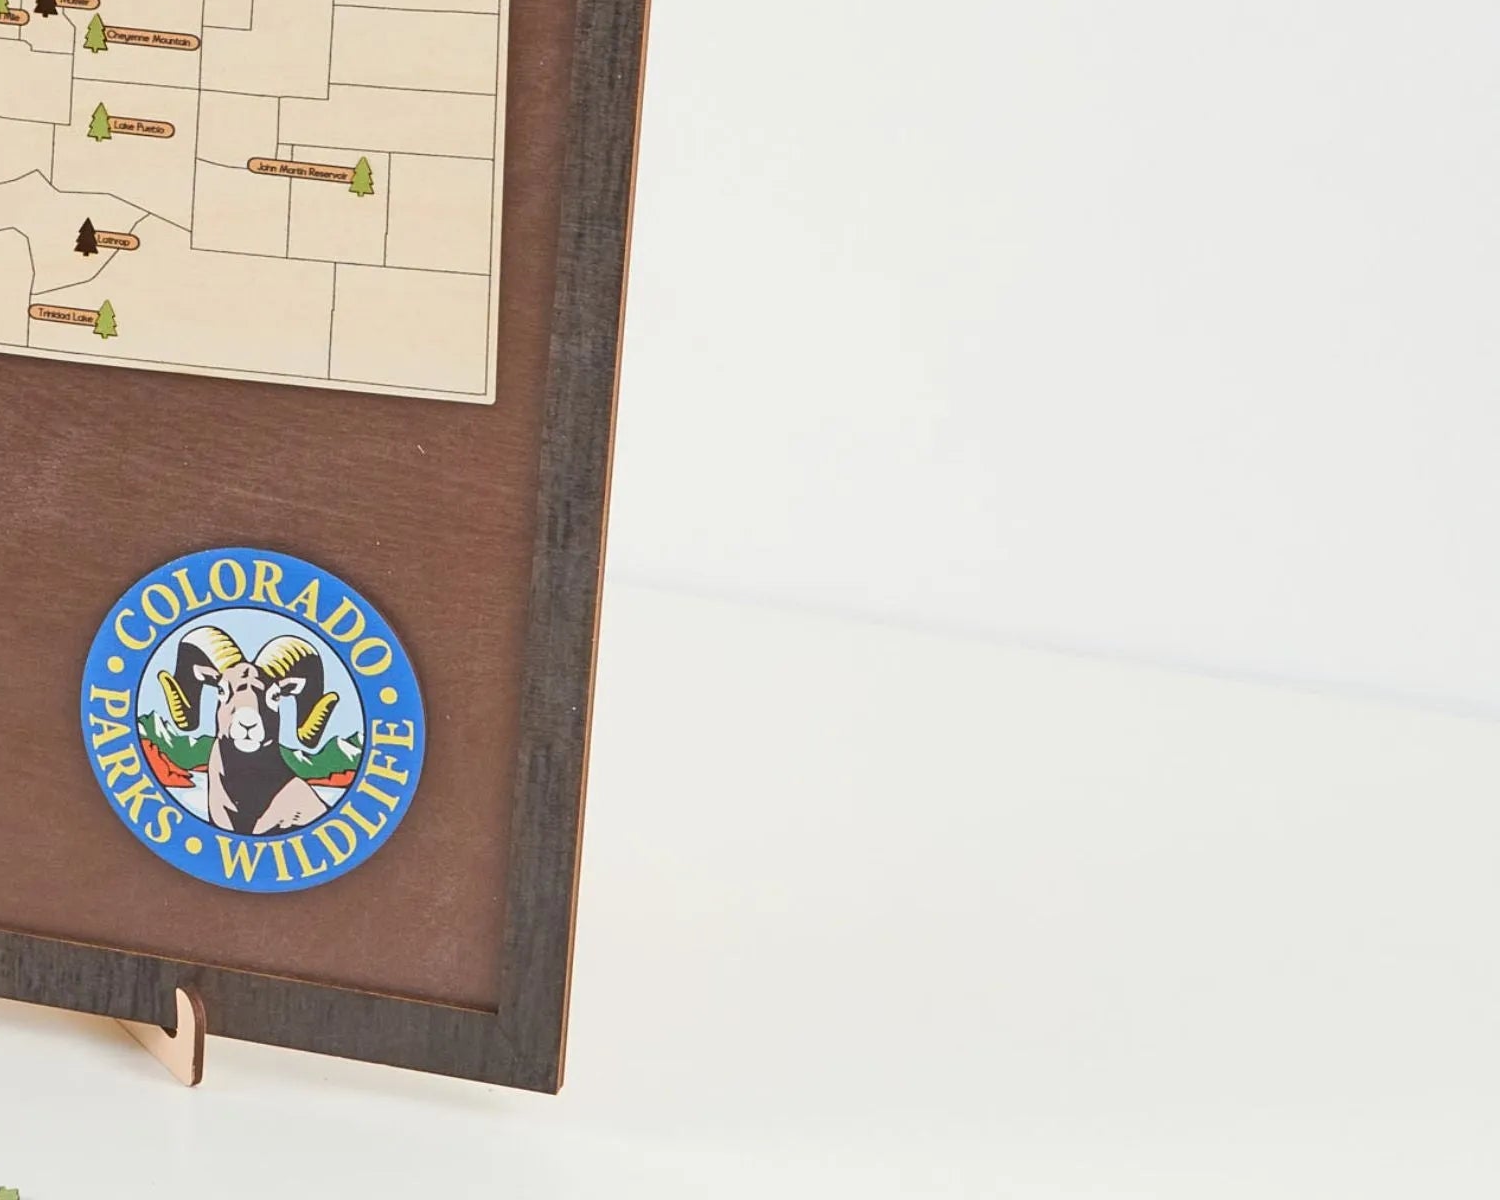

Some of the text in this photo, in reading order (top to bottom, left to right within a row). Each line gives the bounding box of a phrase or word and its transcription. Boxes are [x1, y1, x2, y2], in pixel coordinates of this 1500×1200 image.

[107, 30, 191, 46] Cheyenne Mountain
[114, 120, 165, 134] Lake Pueblo
[257, 163, 348, 180] John Martin Reservoir
[97, 234, 131, 247] Lathrop
[38, 308, 94, 323] Trinidad Lake
[114, 558, 394, 676] COLORADO
[90, 684, 183, 844] PARKS
[216, 719, 415, 883] WILDLIFE
